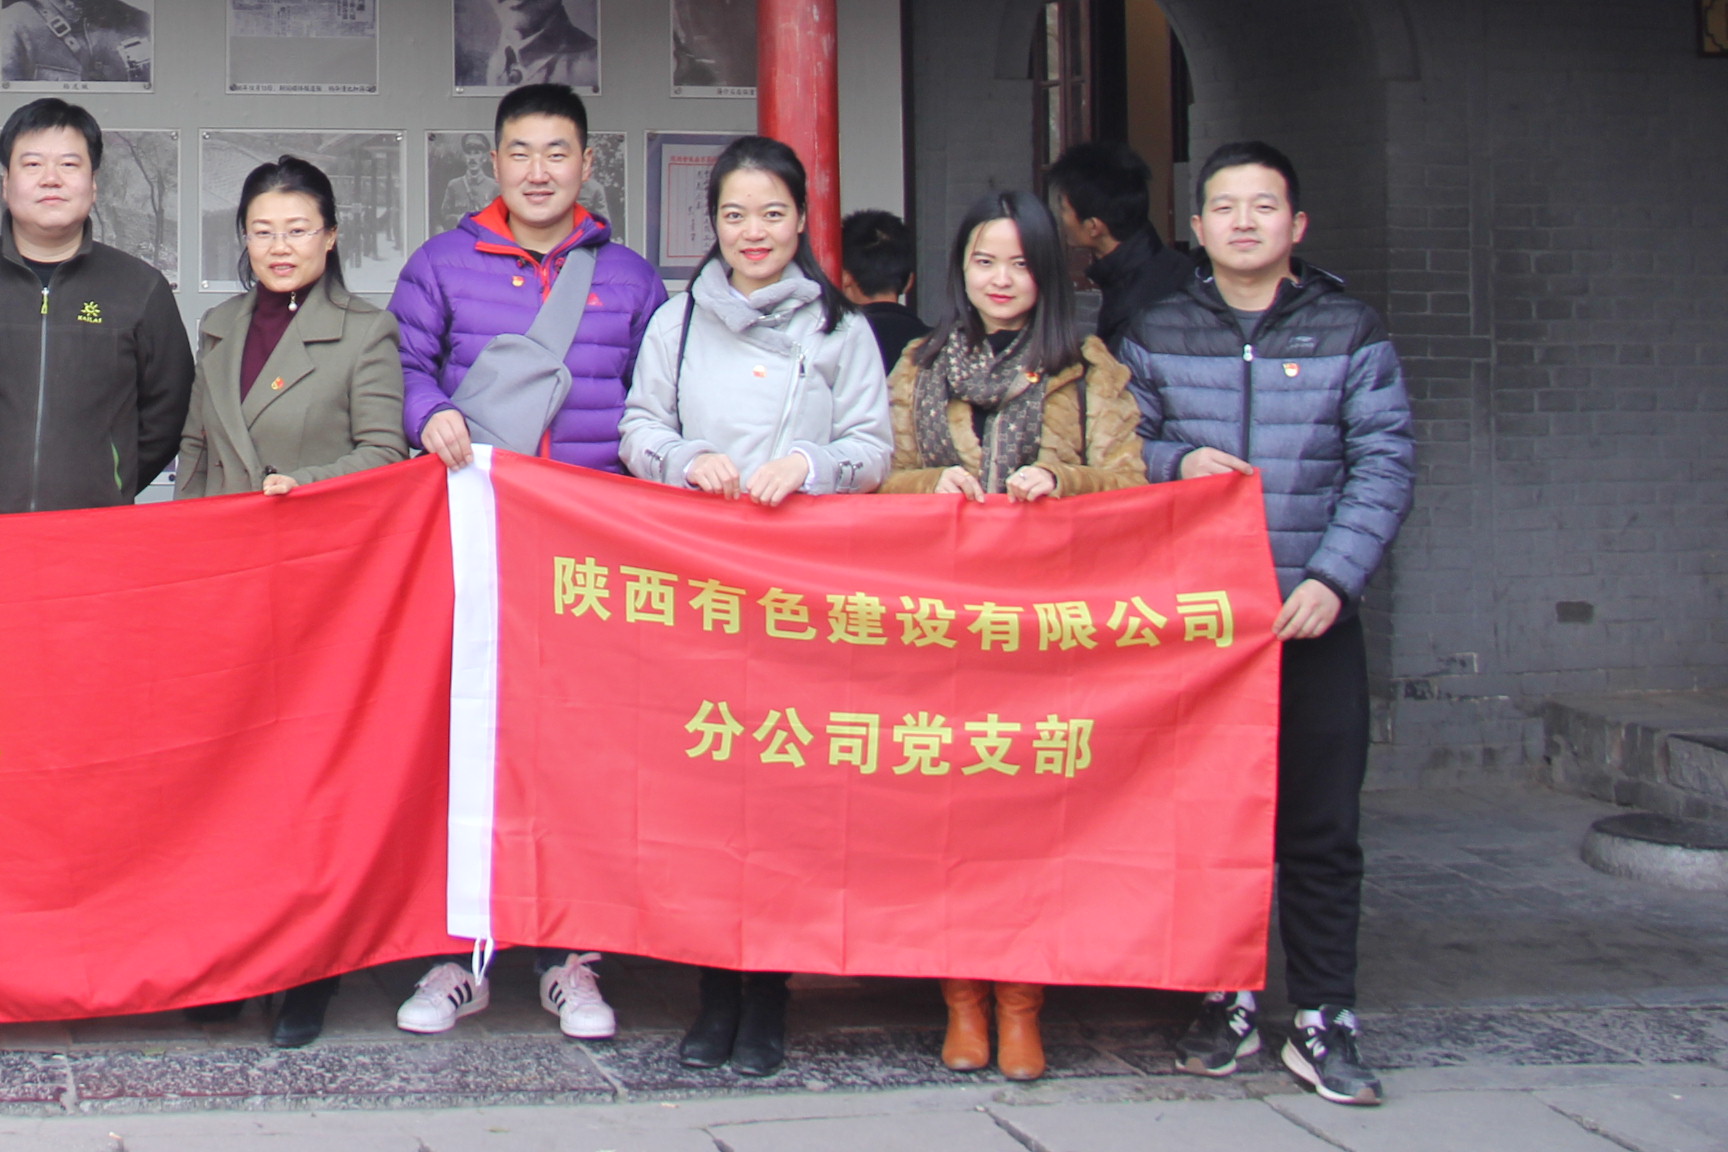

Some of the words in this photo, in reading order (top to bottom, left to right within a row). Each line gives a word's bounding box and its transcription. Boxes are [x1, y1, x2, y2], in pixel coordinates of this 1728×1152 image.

[553, 555, 1235, 652] 陕西有色建设有限公司
[684, 699, 1094, 779] 分公司党支部
